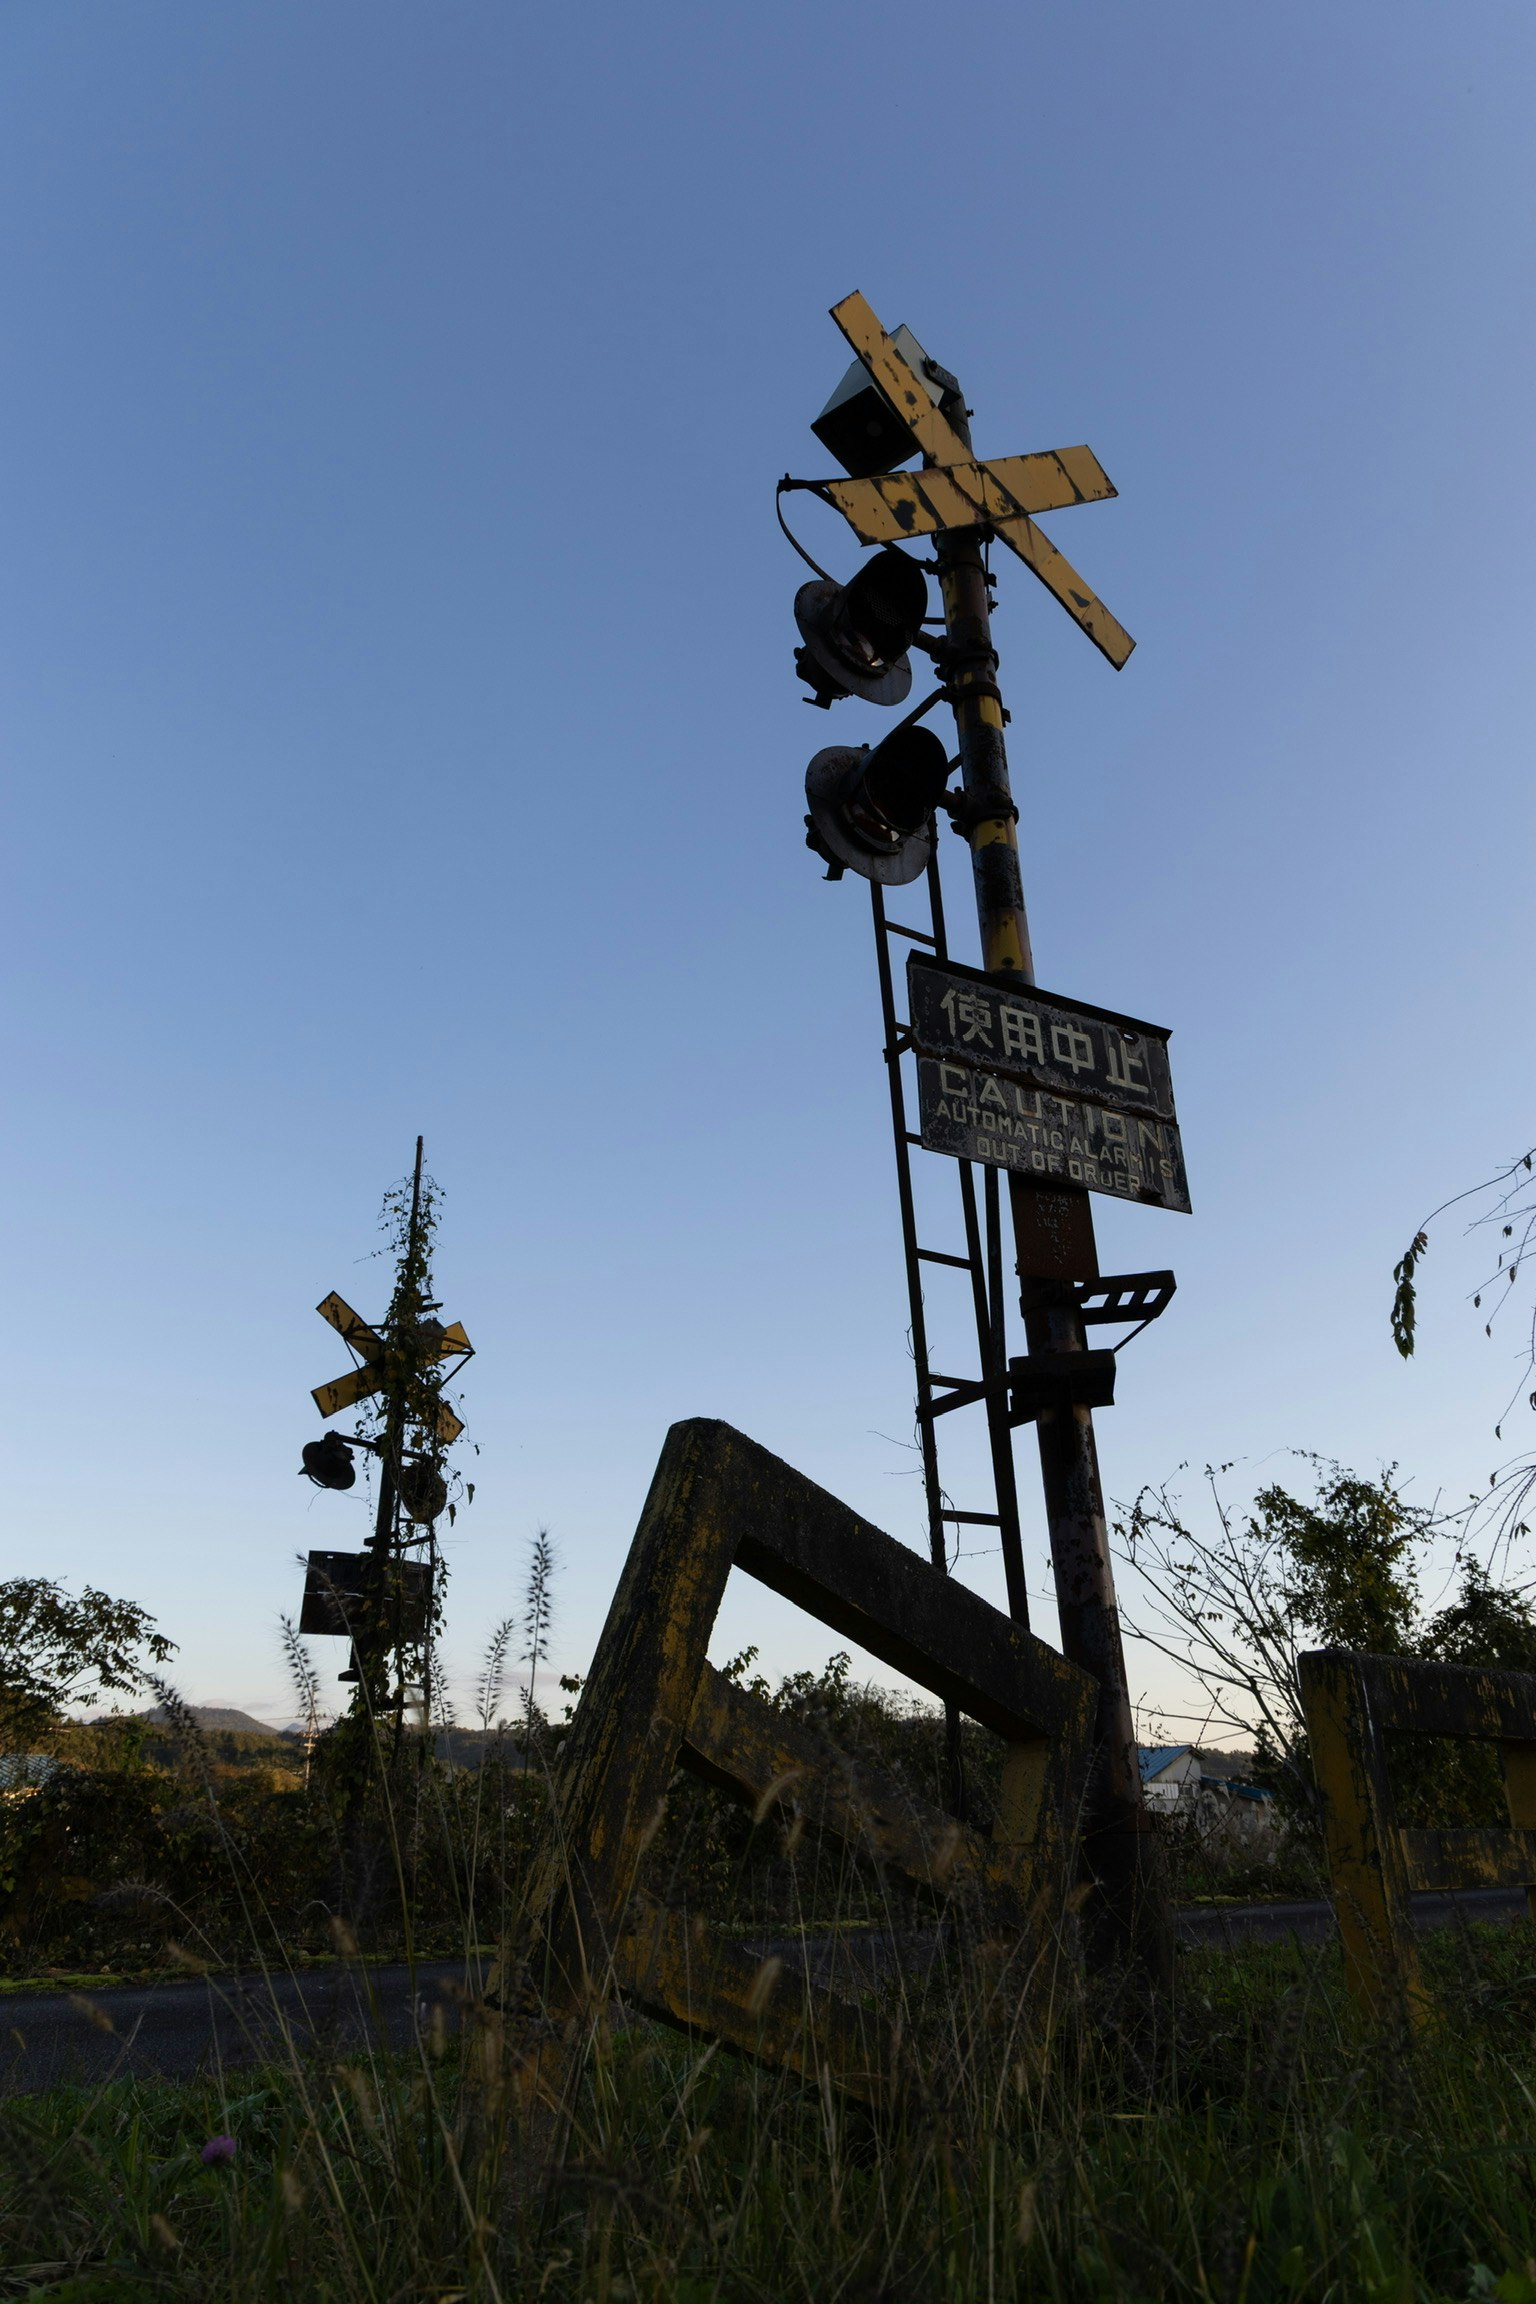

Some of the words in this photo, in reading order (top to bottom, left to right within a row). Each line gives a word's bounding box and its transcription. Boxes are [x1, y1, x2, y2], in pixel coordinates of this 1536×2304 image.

[941, 988, 1149, 1094] 使用中止
[938, 1101, 1063, 1150] AUTOMATIC
[1070, 1136, 1143, 1170] ALARM
[1151, 1157, 1173, 1179] IS
[940, 1064, 1163, 1152] CAUTION
[977, 1136, 1021, 1163] OUT
[1032, 1150, 1061, 1173] OF
